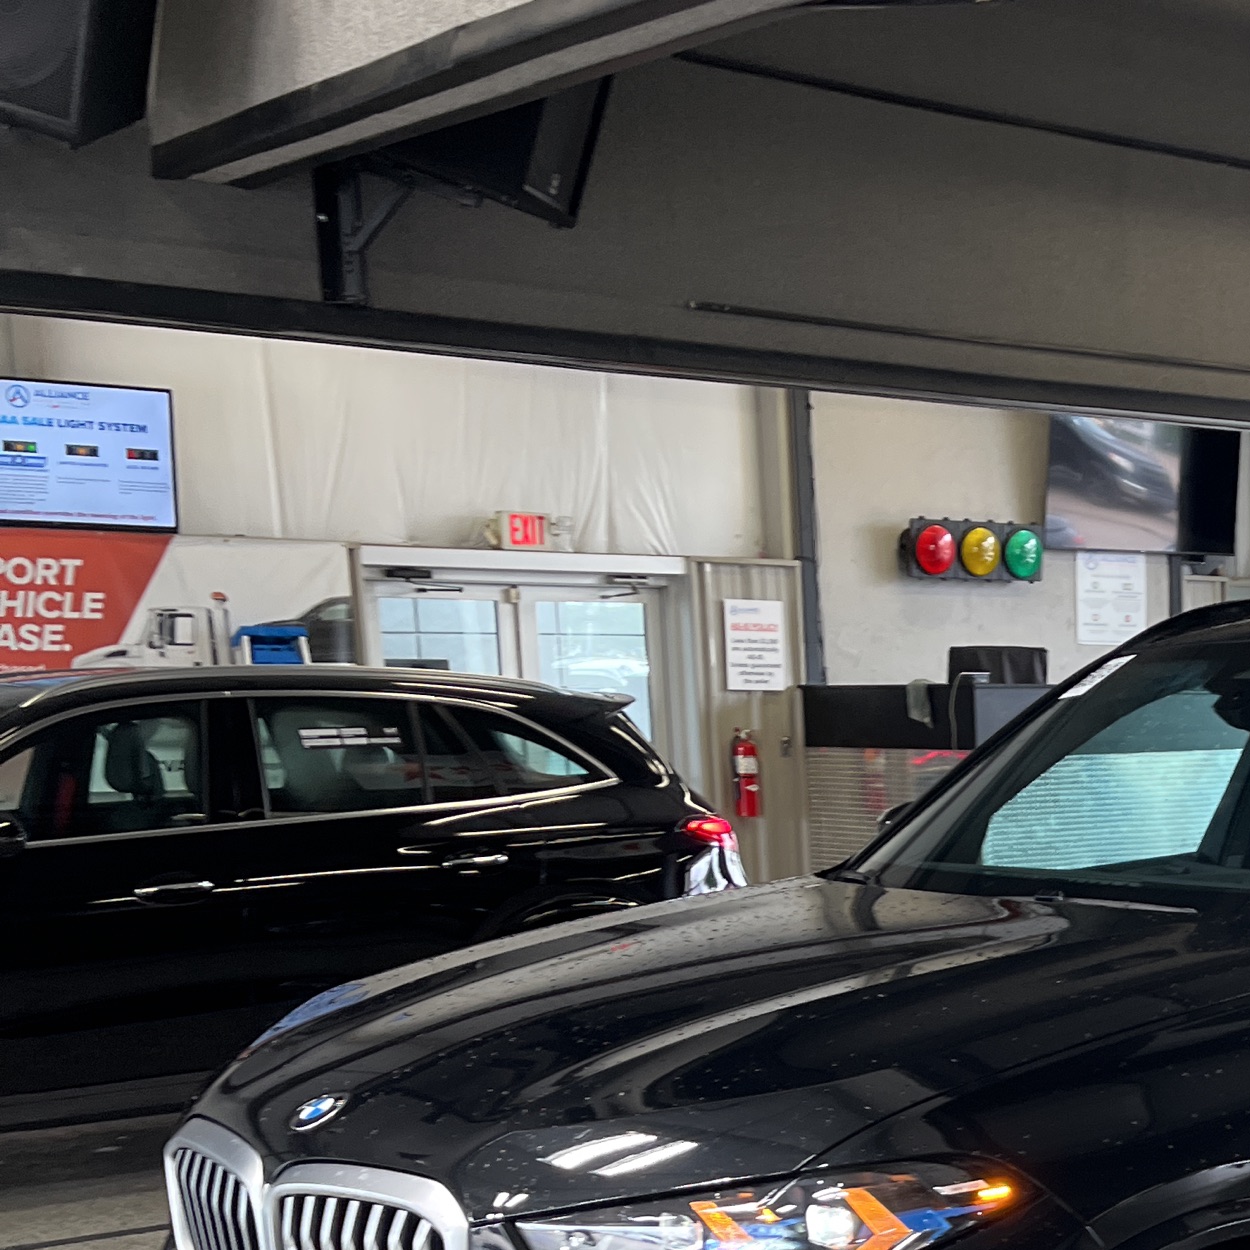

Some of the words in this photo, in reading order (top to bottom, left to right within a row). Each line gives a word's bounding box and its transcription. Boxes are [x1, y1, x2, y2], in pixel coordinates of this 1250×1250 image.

[56, 418, 94, 430] LIGHT
[98, 421, 149, 433] SYSTEM
[509, 514, 545, 546] EXIT
